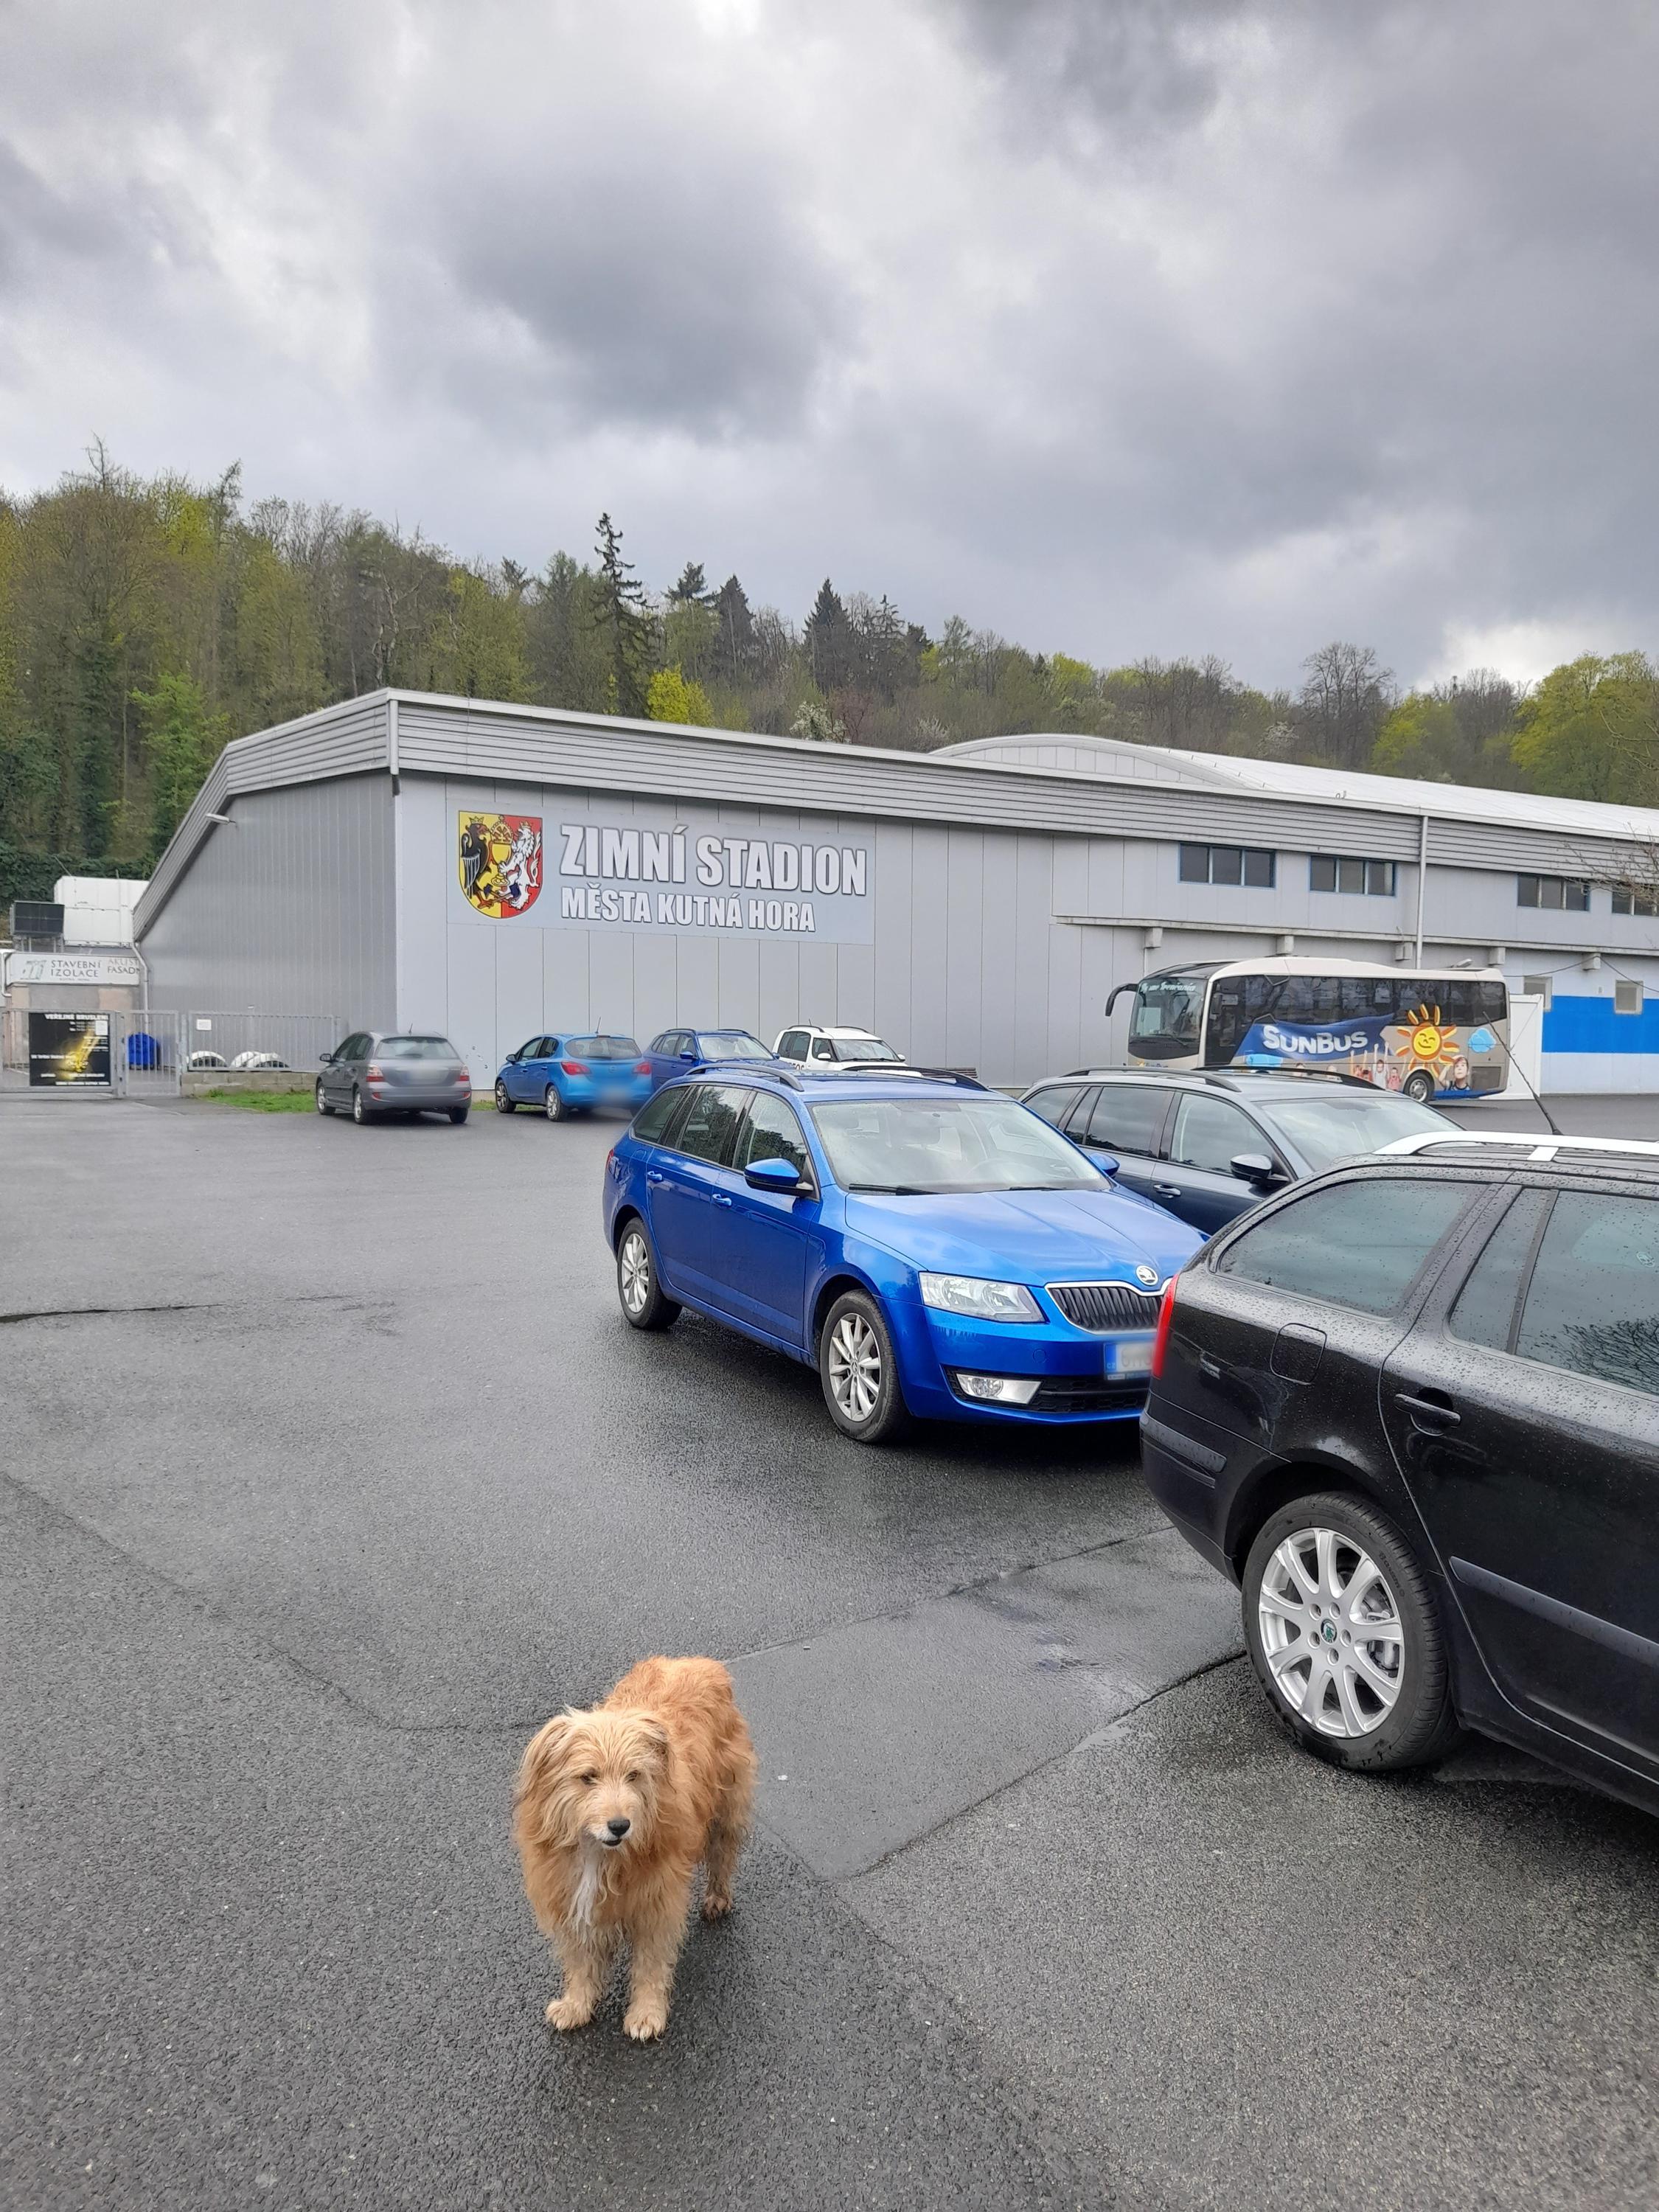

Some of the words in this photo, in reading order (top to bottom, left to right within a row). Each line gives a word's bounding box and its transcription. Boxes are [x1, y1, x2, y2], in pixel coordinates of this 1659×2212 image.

[560, 824, 689, 883] ZIMNÍ
[696, 835, 866, 897] STADION
[561, 882, 653, 922] MĚSTA
[657, 893, 743, 928] KUTNÁ
[748, 899, 815, 932] HORA
[51, 969, 99, 978] IZOLACE
